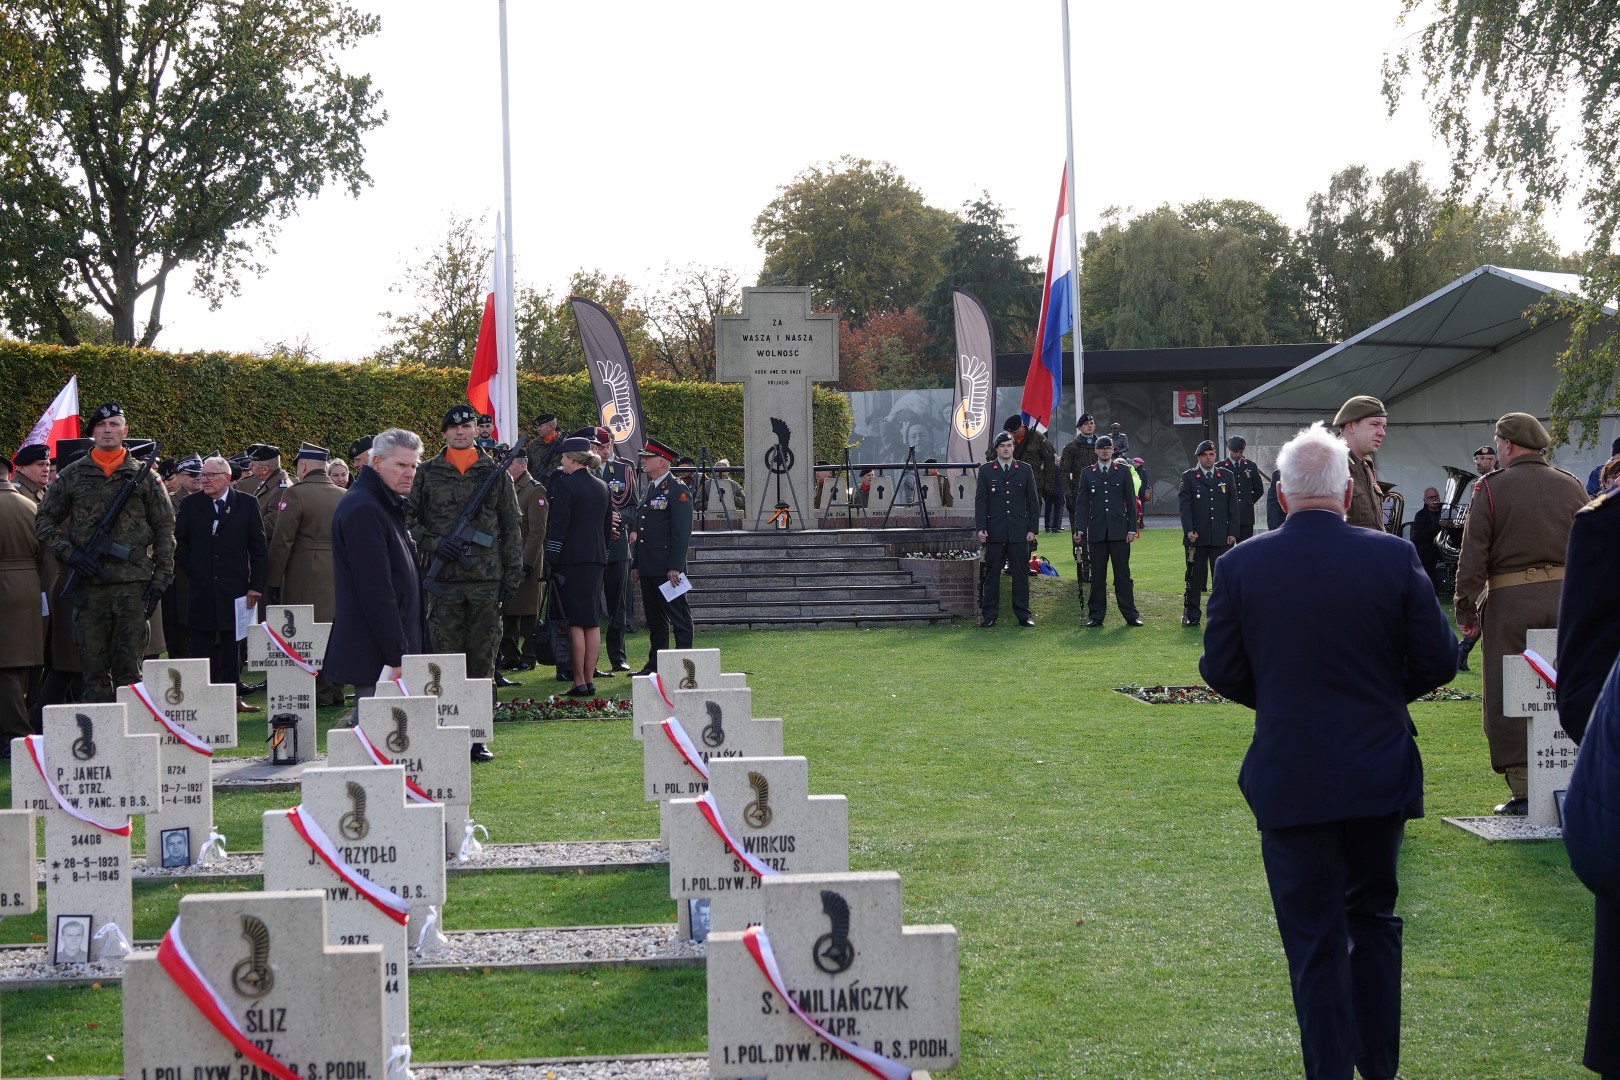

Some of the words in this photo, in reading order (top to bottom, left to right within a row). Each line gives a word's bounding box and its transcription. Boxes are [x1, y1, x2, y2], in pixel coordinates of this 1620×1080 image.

[742, 334, 770, 344] WASZĄ
[785, 334, 814, 344] NASZĄ
[756, 347, 800, 357] WOLNOŚĆ
[165, 710, 198, 721] PERTEK
[470, 729, 488, 738] ODH.
[72, 766, 112, 781] JANETA
[167, 766, 186, 775] 8724
[58, 784, 72, 795] ST.
[78, 782, 106, 794] STRZ.
[32, 800, 54, 810] POL.
[88, 798, 116, 808] PANC.
[742, 835, 796, 854] WIRKUS
[762, 990, 780, 1015] S.
[246, 1001, 287, 1033] ŚLIZ
